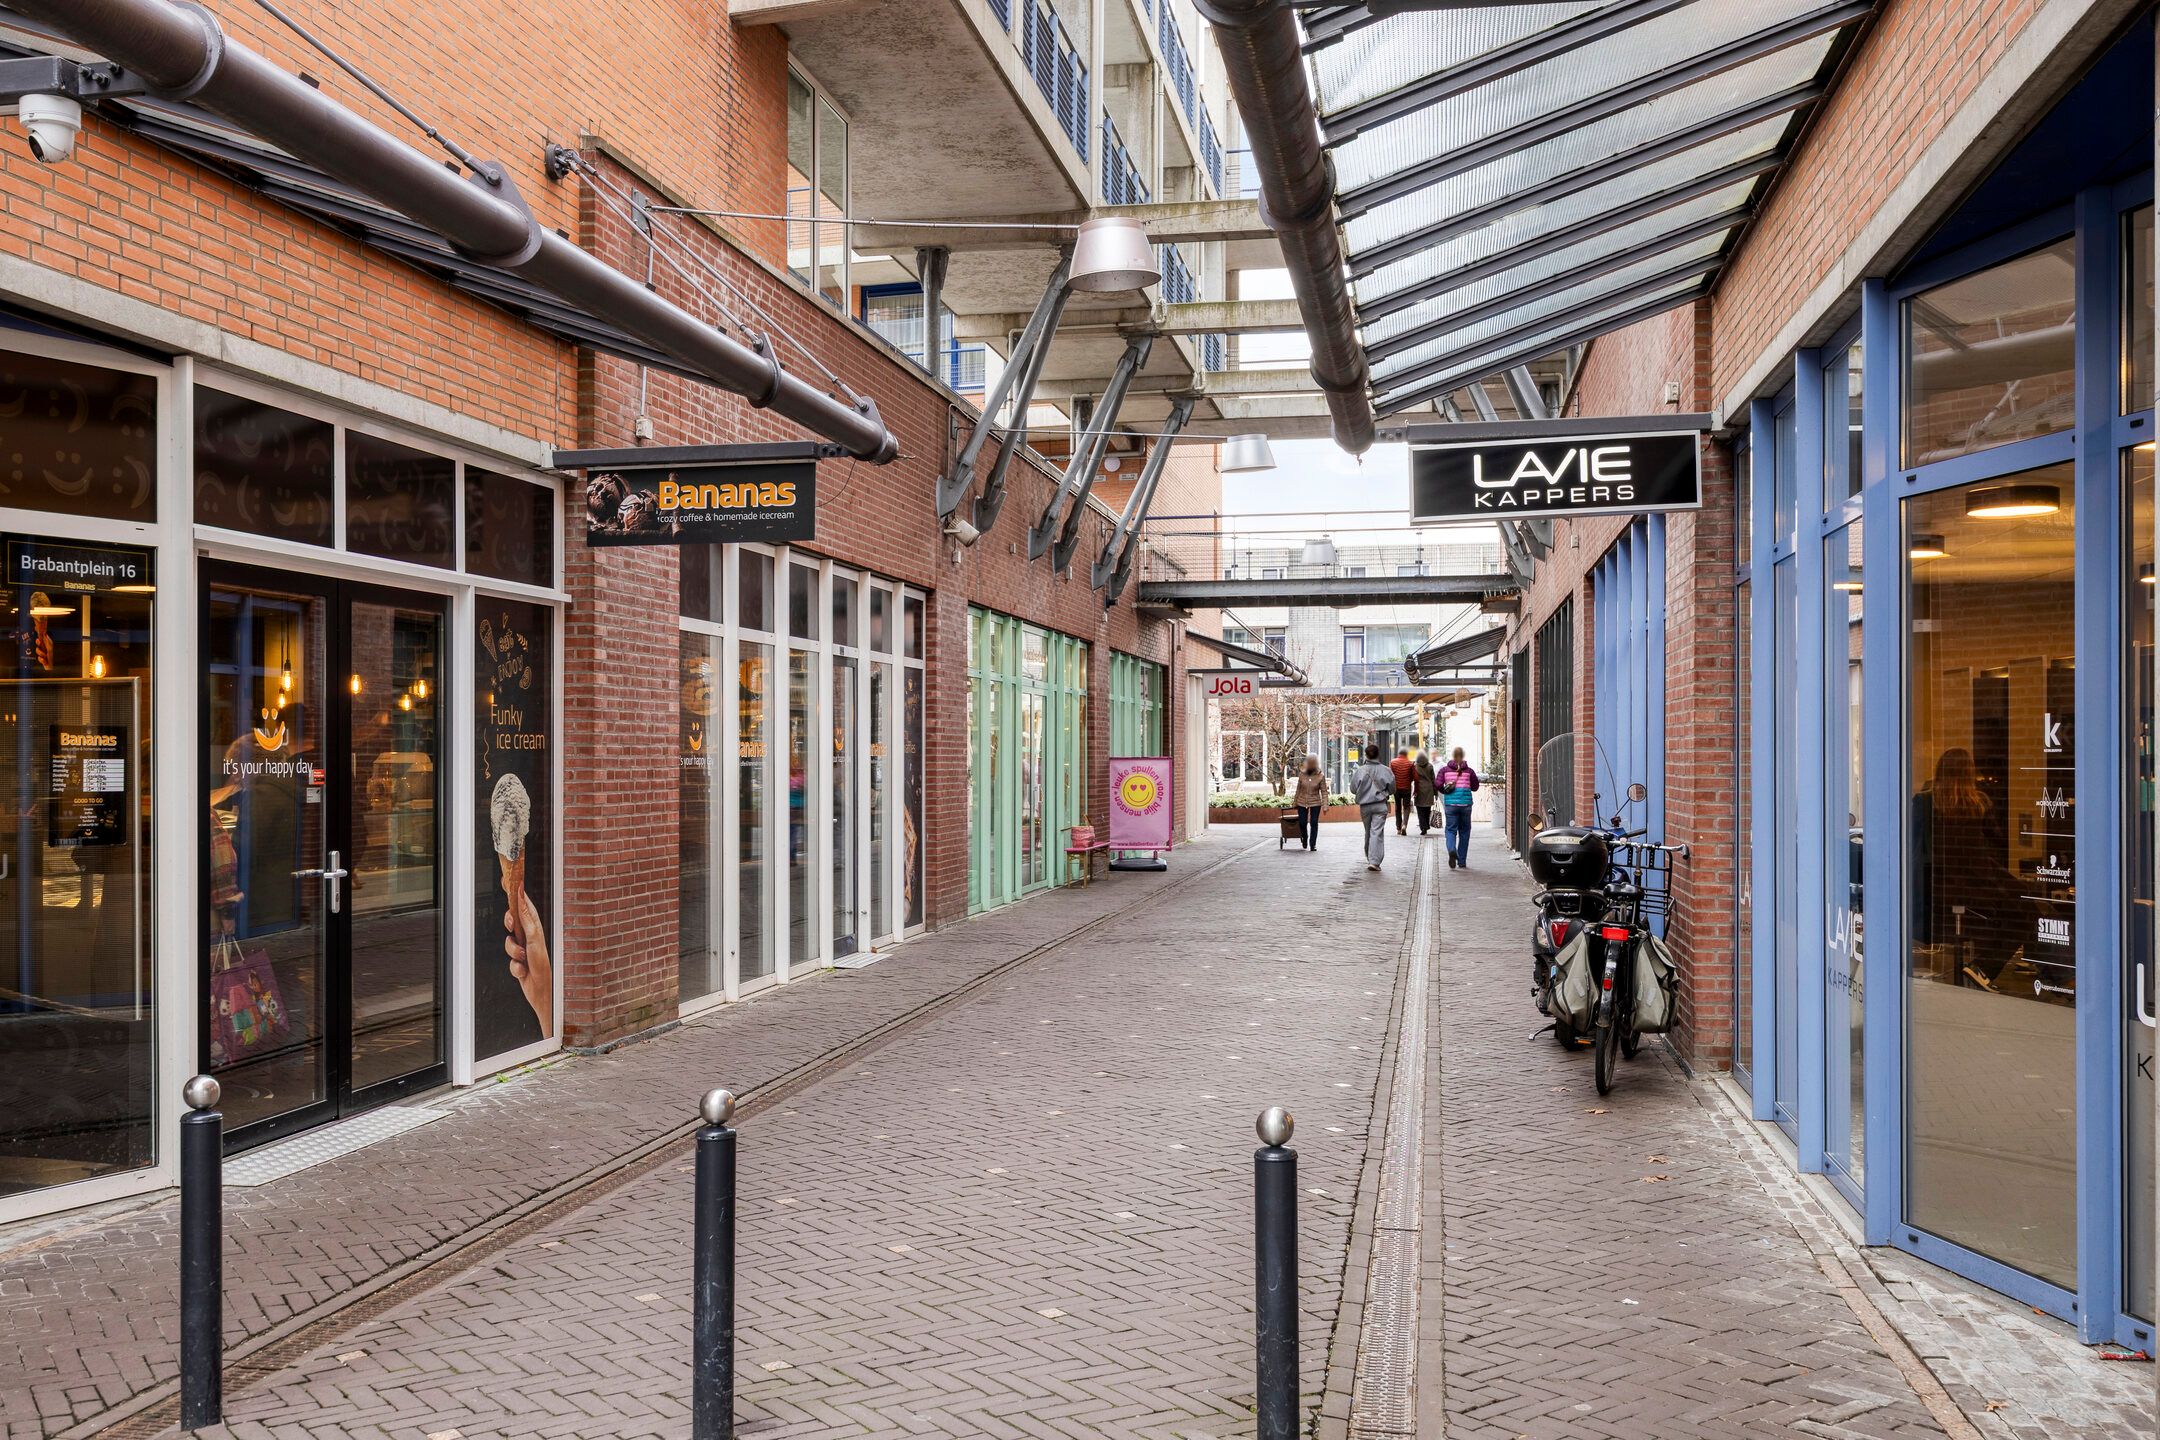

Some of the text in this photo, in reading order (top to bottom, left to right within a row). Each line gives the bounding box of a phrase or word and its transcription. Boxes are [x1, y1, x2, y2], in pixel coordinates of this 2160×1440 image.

[659, 481, 796, 511] Bananas
[1474, 485, 1635, 508] KAPPERS
[660, 510, 795, 523] cozy coffee & homemade icecream
[21, 554, 136, 578] Brabantplein 16
[64, 581, 96, 590] Bananas
[1208, 676, 1251, 694] Jola
[490, 703, 523, 731] Funky
[60, 732, 118, 747] Bananas
[496, 729, 545, 750] ice cream
[2044, 713, 2061, 748] k
[737, 741, 768, 758] ananas
[223, 759, 239, 774] it's
[241, 761, 263, 778] your
[265, 758, 295, 778] happy
[1112, 768, 1130, 789] leuke
[1131, 765, 1160, 780] spullen
[1156, 780, 1164, 802] voor
[1114, 796, 1142, 817] mensen
[2036, 865, 2071, 880] Schwarzkopf
[2037, 917, 2070, 936] STMNT
[1827, 966, 1863, 1004] KAPPERS
